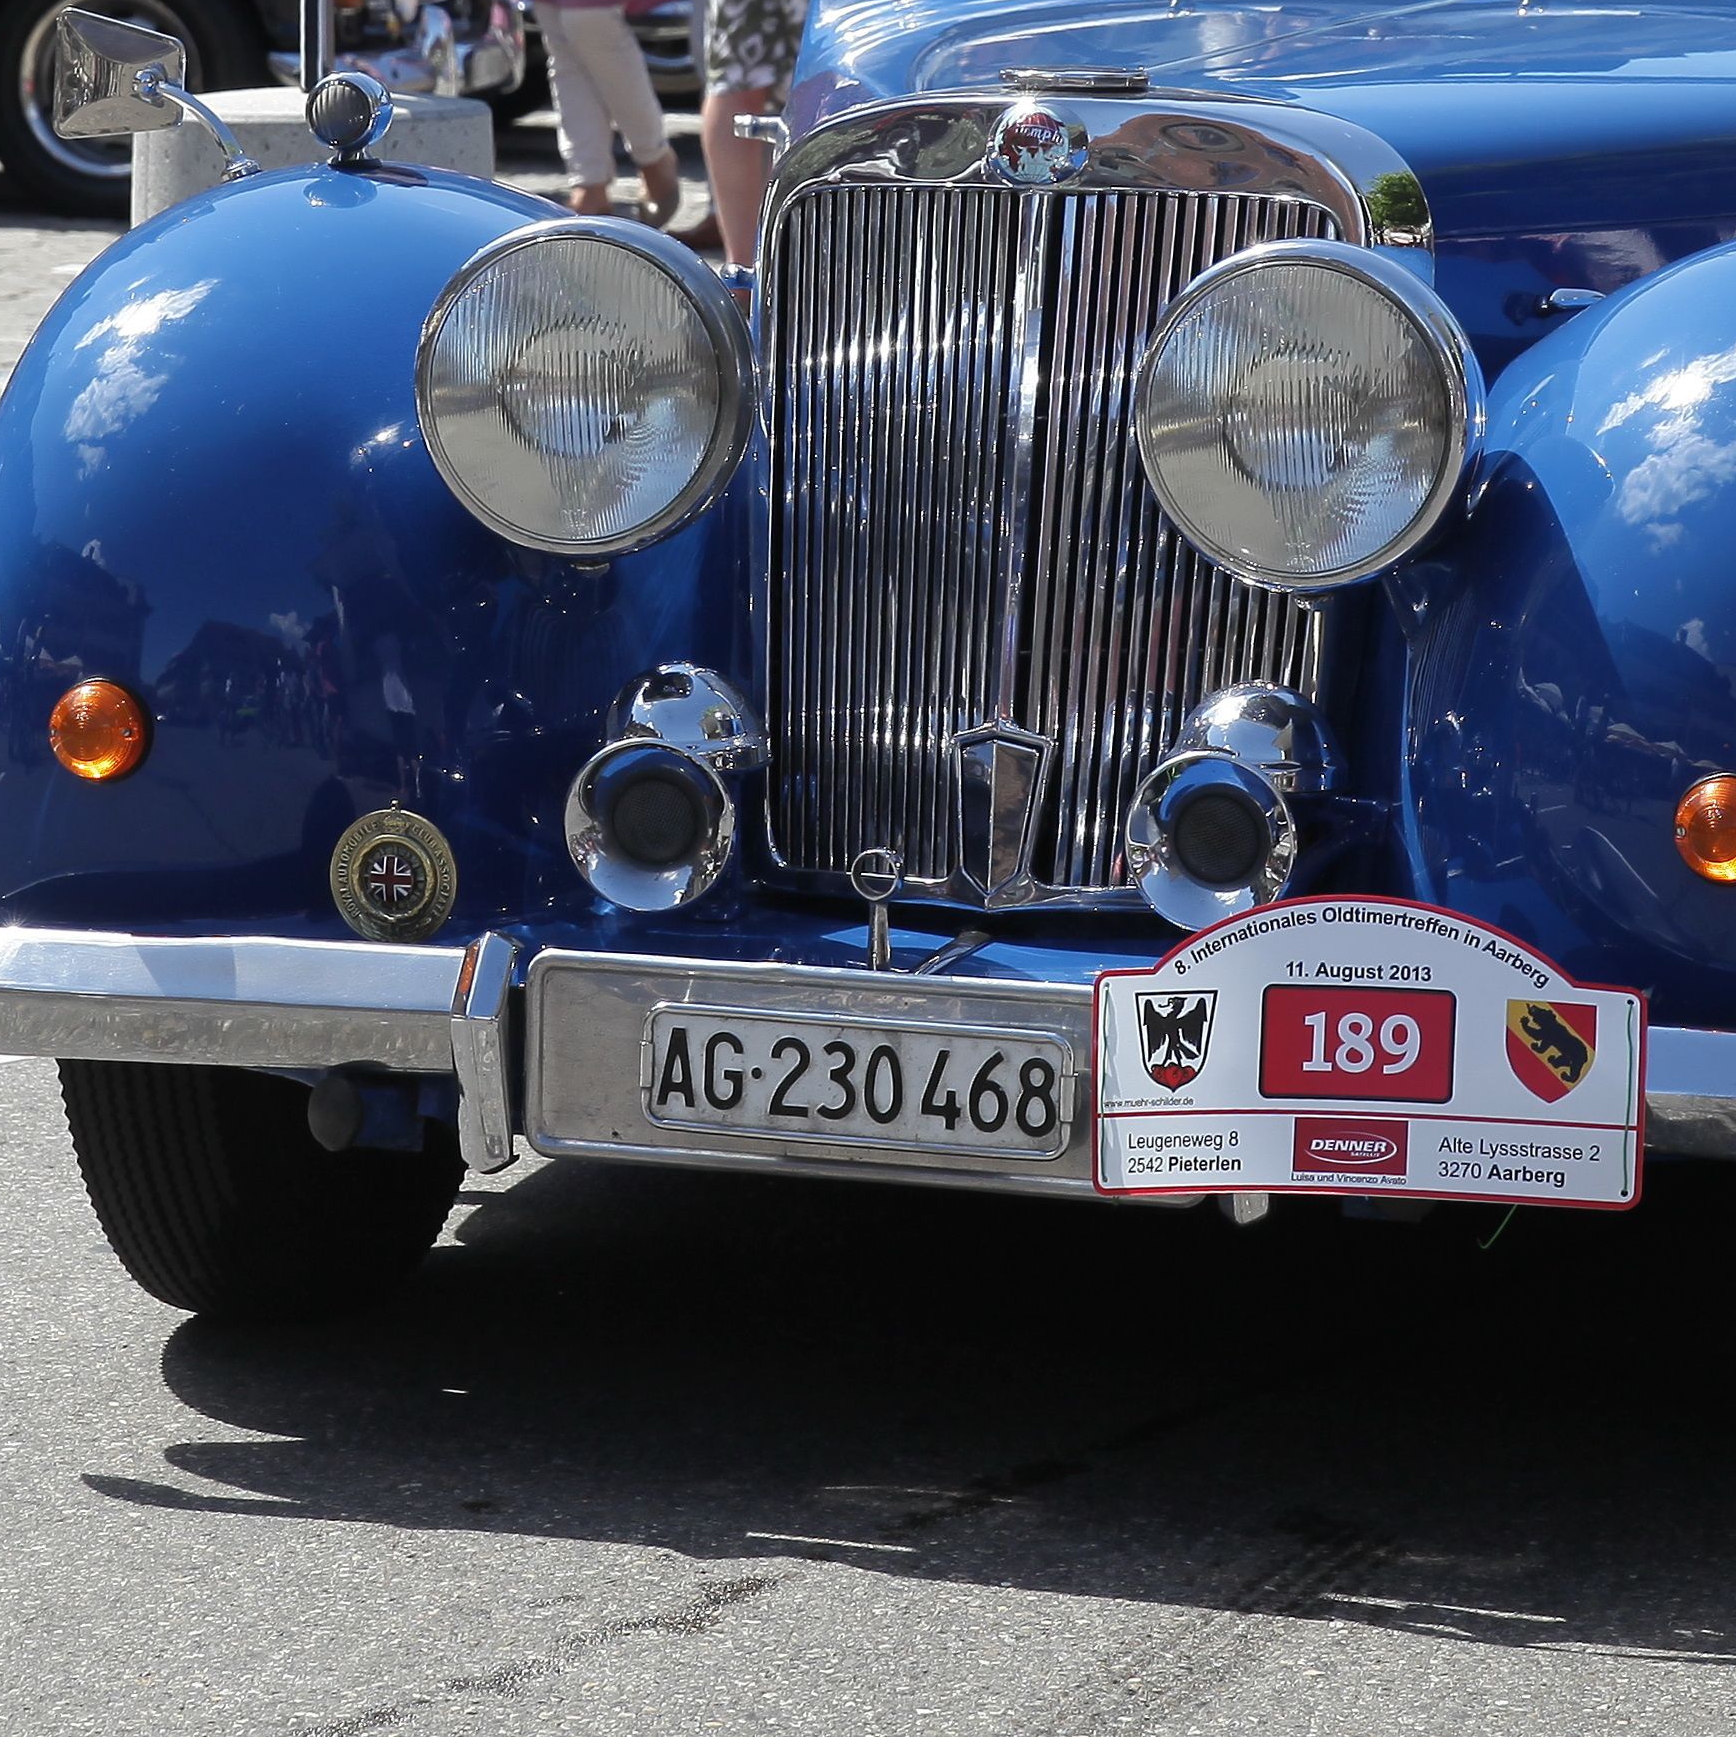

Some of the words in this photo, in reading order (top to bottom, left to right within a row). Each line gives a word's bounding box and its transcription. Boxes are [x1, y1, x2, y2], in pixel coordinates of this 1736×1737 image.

[1174, 959, 1191, 975] 8.
[1191, 911, 1317, 964] Internationales
[1322, 906, 1460, 941] Oldtimertreffen
[1463, 929, 1481, 949] in
[1482, 939, 1550, 990] Aarberg
[1285, 961, 1309, 978] 11.
[1315, 962, 1384, 983] August
[1389, 964, 1432, 982] 2013
[1301, 1010, 1422, 1075] 189
[1128, 1133, 1223, 1152] Leugeneweg
[1228, 1130, 1239, 1147] 8
[1310, 1139, 1387, 1153] DENNER
[1438, 1136, 1474, 1154] Alte
[1479, 1139, 1583, 1161] Lyssstrasse
[1589, 1145, 1601, 1162] 2
[1127, 1156, 1164, 1173] 2542
[1167, 1155, 1242, 1172] Pieterlen
[1438, 1162, 1482, 1179] 3270
[1487, 1164, 1565, 1188] Aarberg
[1291, 1172, 1315, 1182] Luisa
[1317, 1174, 1335, 1183] und
[1336, 1174, 1378, 1184] Vincenzo
